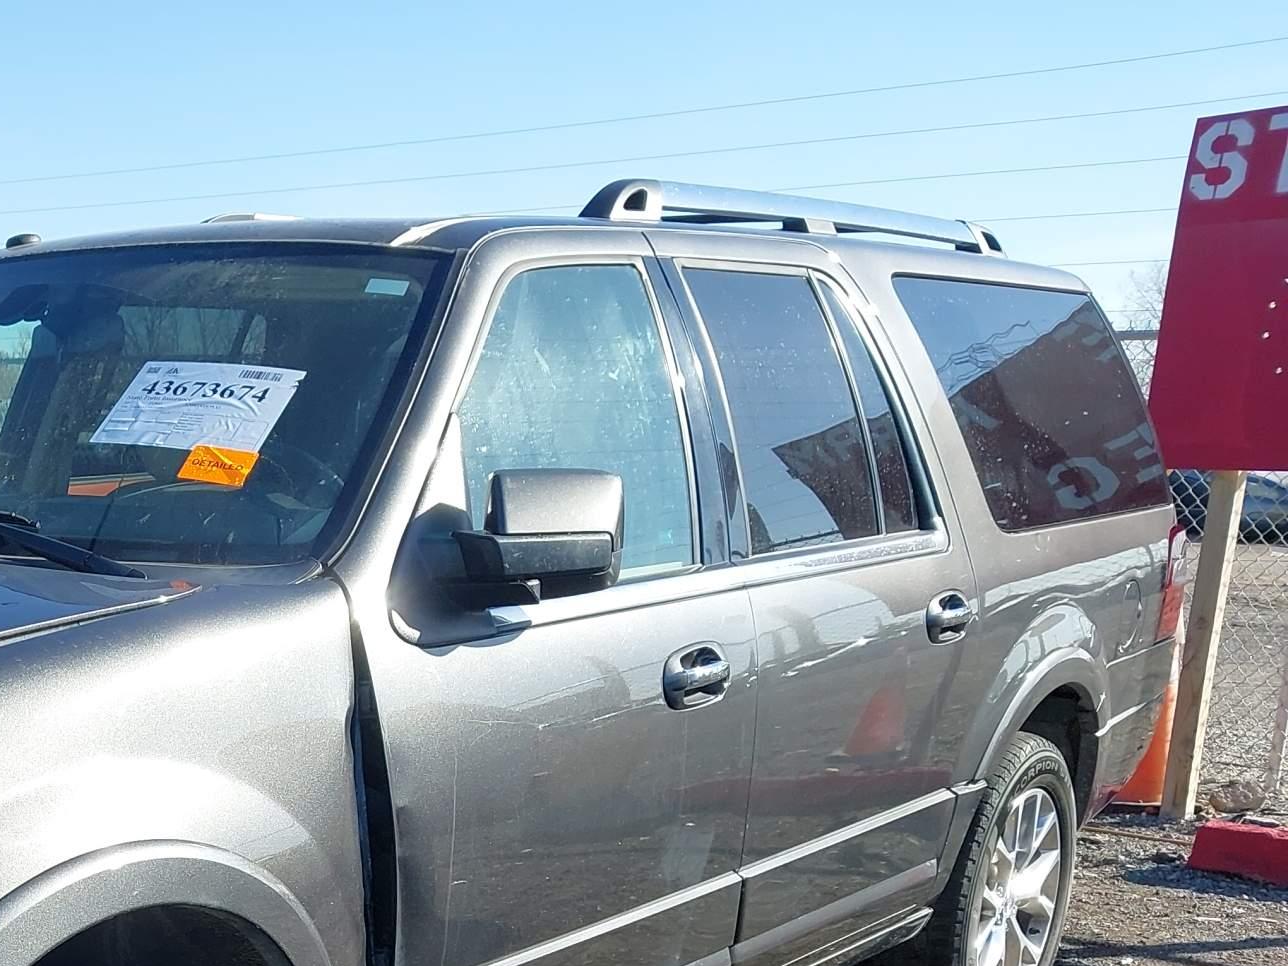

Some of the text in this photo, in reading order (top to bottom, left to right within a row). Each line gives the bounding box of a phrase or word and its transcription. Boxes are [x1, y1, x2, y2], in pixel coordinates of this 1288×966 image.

[142, 380, 271, 403] 43673674
[192, 458, 243, 471] DETAILED
[1013, 760, 1059, 798] CORPION
